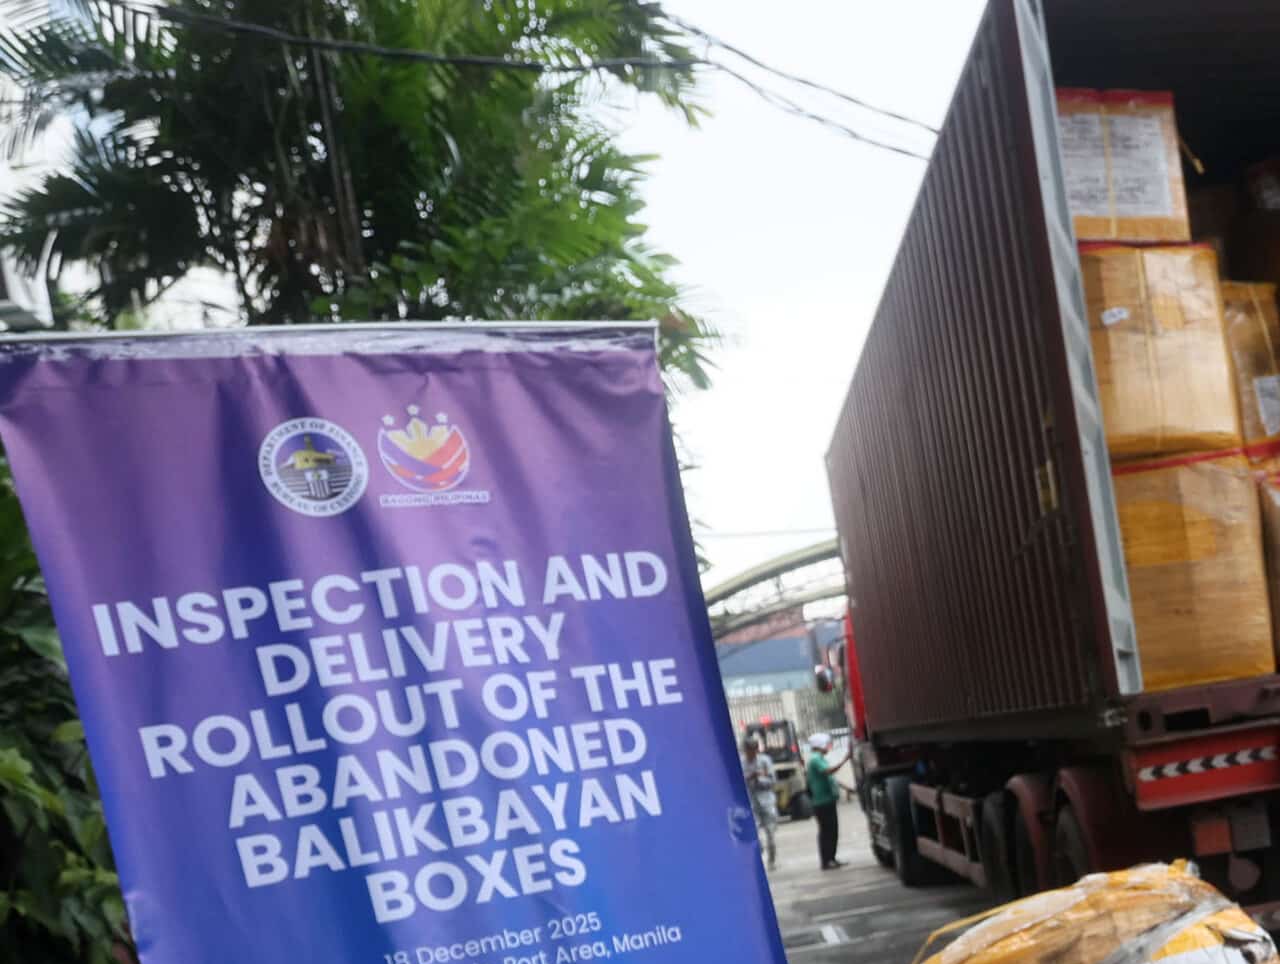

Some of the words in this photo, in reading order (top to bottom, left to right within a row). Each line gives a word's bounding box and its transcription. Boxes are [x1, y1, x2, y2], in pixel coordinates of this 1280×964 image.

[92, 560, 526, 656] INSPECTION
[543, 551, 668, 605] AND
[256, 612, 565, 696] DELIVERY
[138, 679, 463, 778] ROLLOUT
[482, 670, 557, 722] OF
[570, 658, 683, 713] THE
[229, 718, 647, 828] ABANDONED
[236, 770, 662, 888] BALIKBAYAN
[365, 838, 587, 924] BOXES
[547, 911, 602, 941] 2025
[611, 923, 683, 955] Manila
